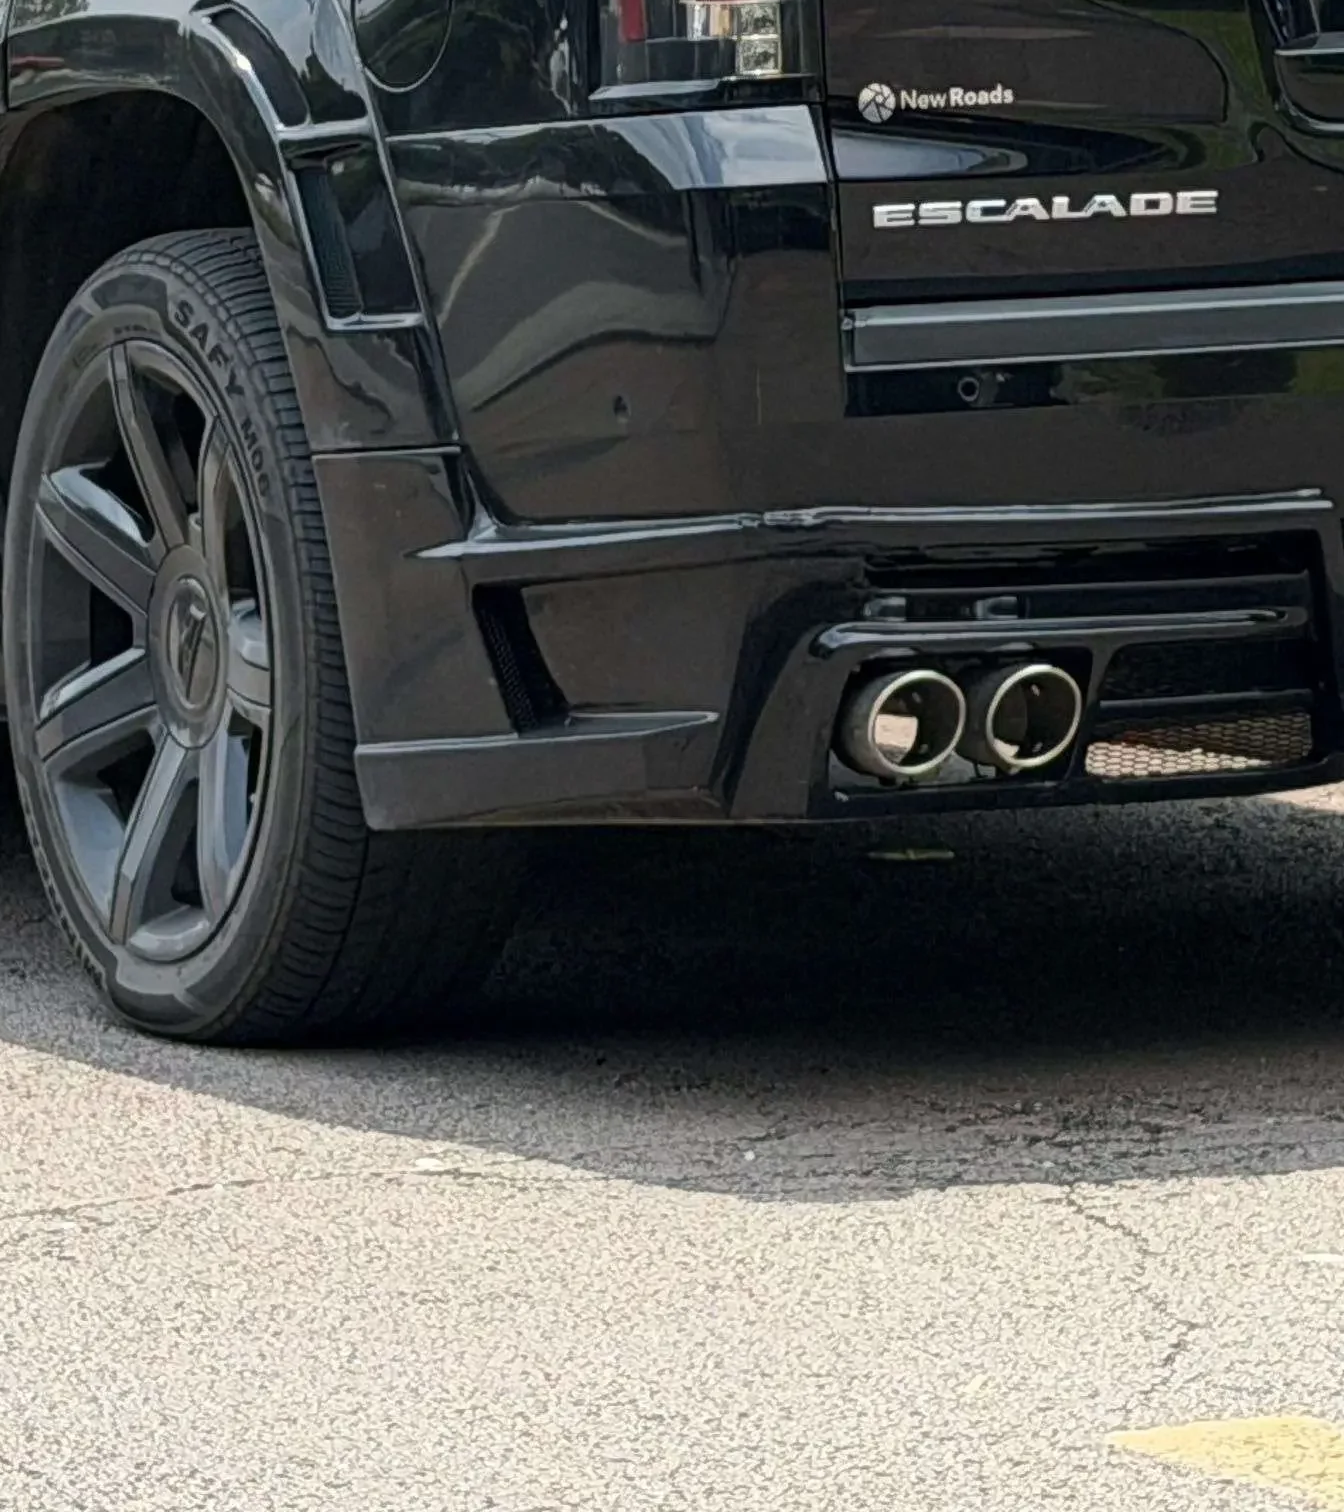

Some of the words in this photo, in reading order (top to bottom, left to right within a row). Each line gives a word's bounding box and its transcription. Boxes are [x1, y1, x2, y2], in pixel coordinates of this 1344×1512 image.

[900, 89, 947, 110] New
[948, 83, 1014, 107] Roads
[872, 190, 1219, 228] ESCALADE
